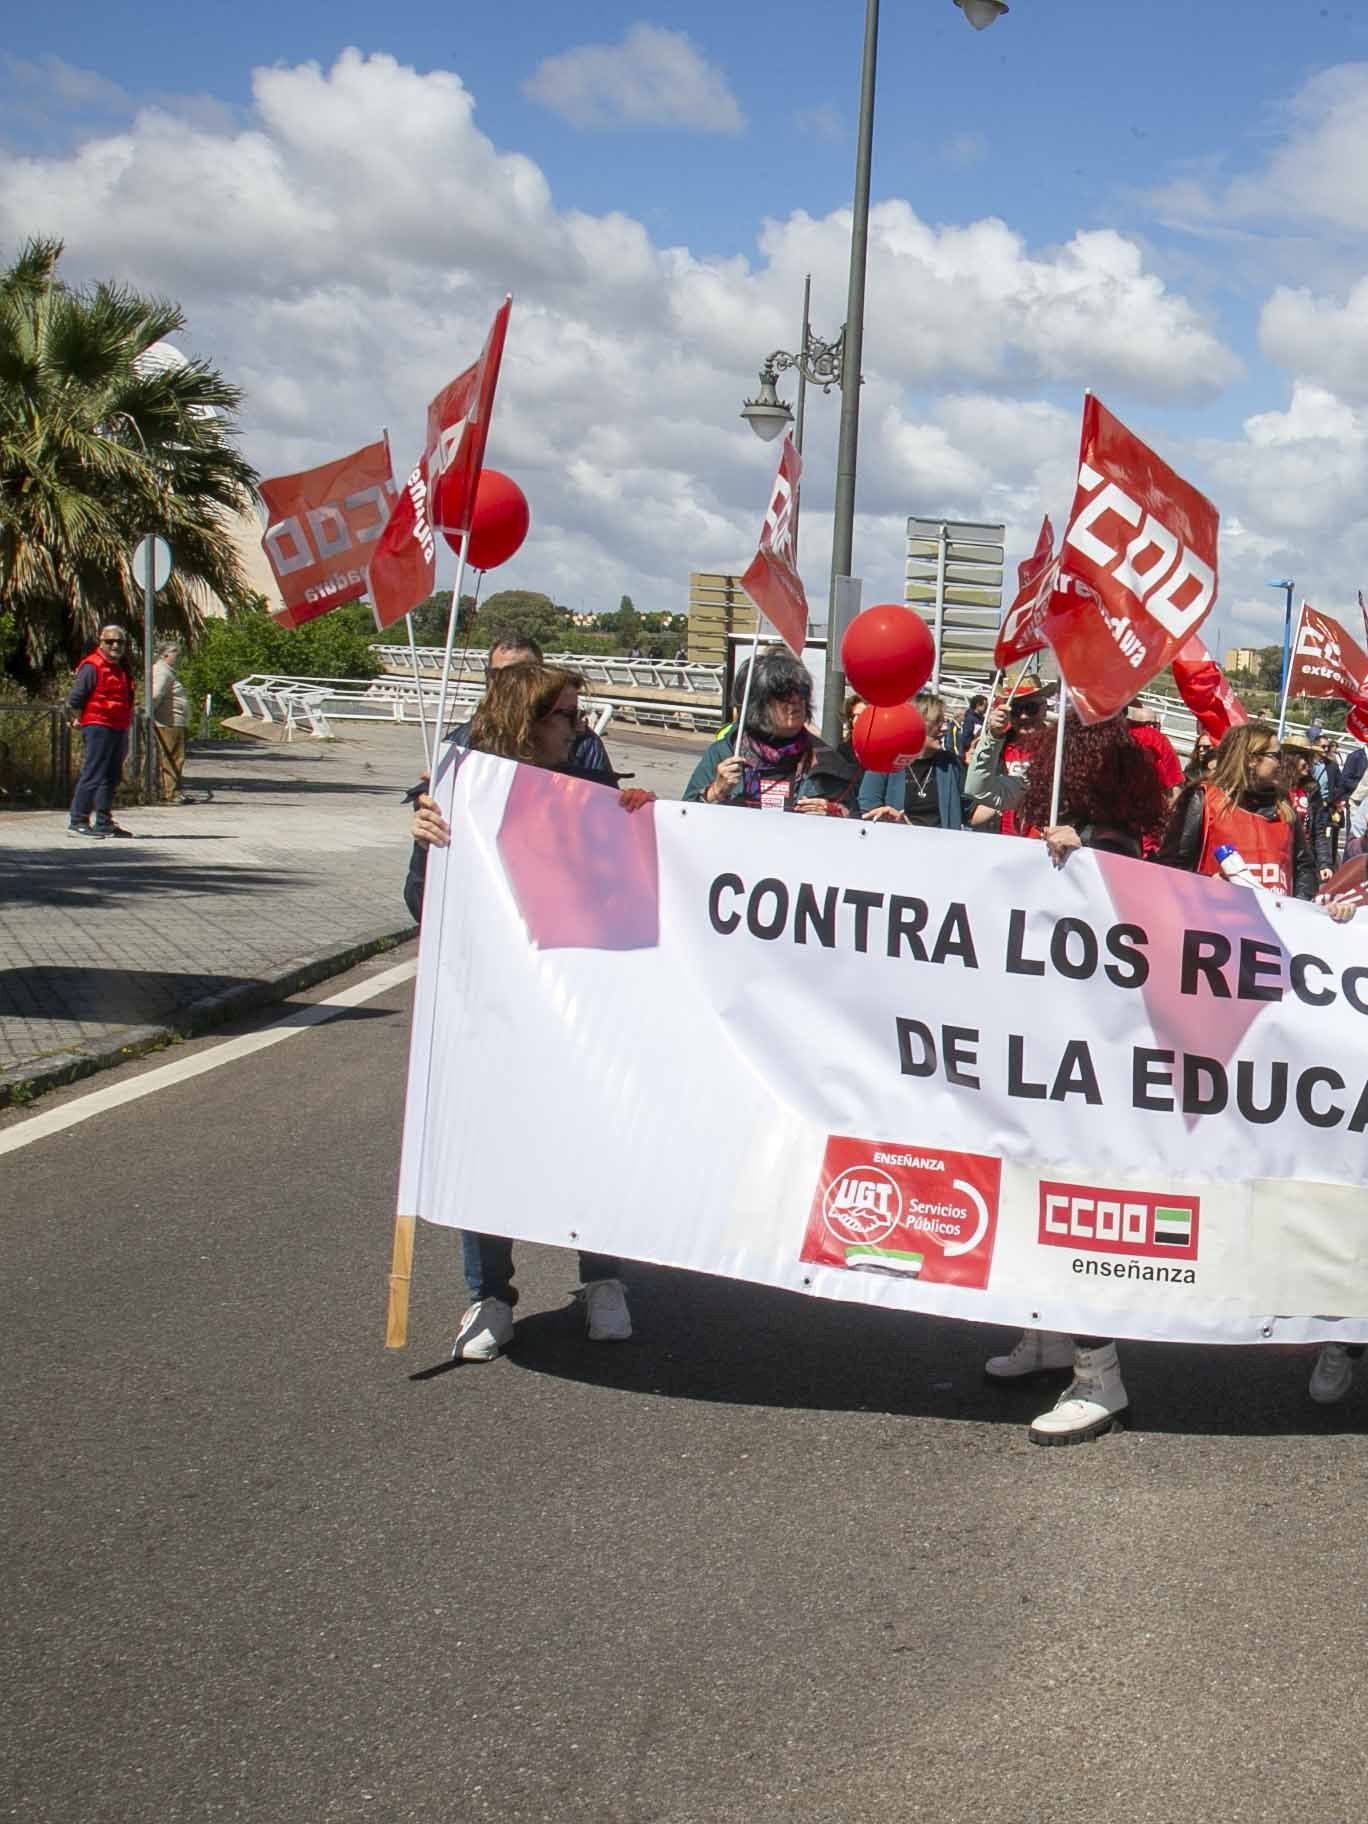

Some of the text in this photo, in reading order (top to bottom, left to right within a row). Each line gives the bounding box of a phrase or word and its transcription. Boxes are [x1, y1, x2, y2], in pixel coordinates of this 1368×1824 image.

[708, 872, 979, 970] CONTRA
[1005, 908, 1150, 989] LOS
[895, 1015, 981, 1090] DE
[1008, 1033, 1105, 1106] LA
[873, 1151, 945, 1172] ENSEÑANZA
[838, 1178, 893, 1211] UGT
[908, 1198, 968, 1220] Servicios
[905, 1214, 962, 1236] Públicos
[1045, 1194, 1148, 1244] CCOO
[1071, 1256, 1197, 1284] enseñanza
